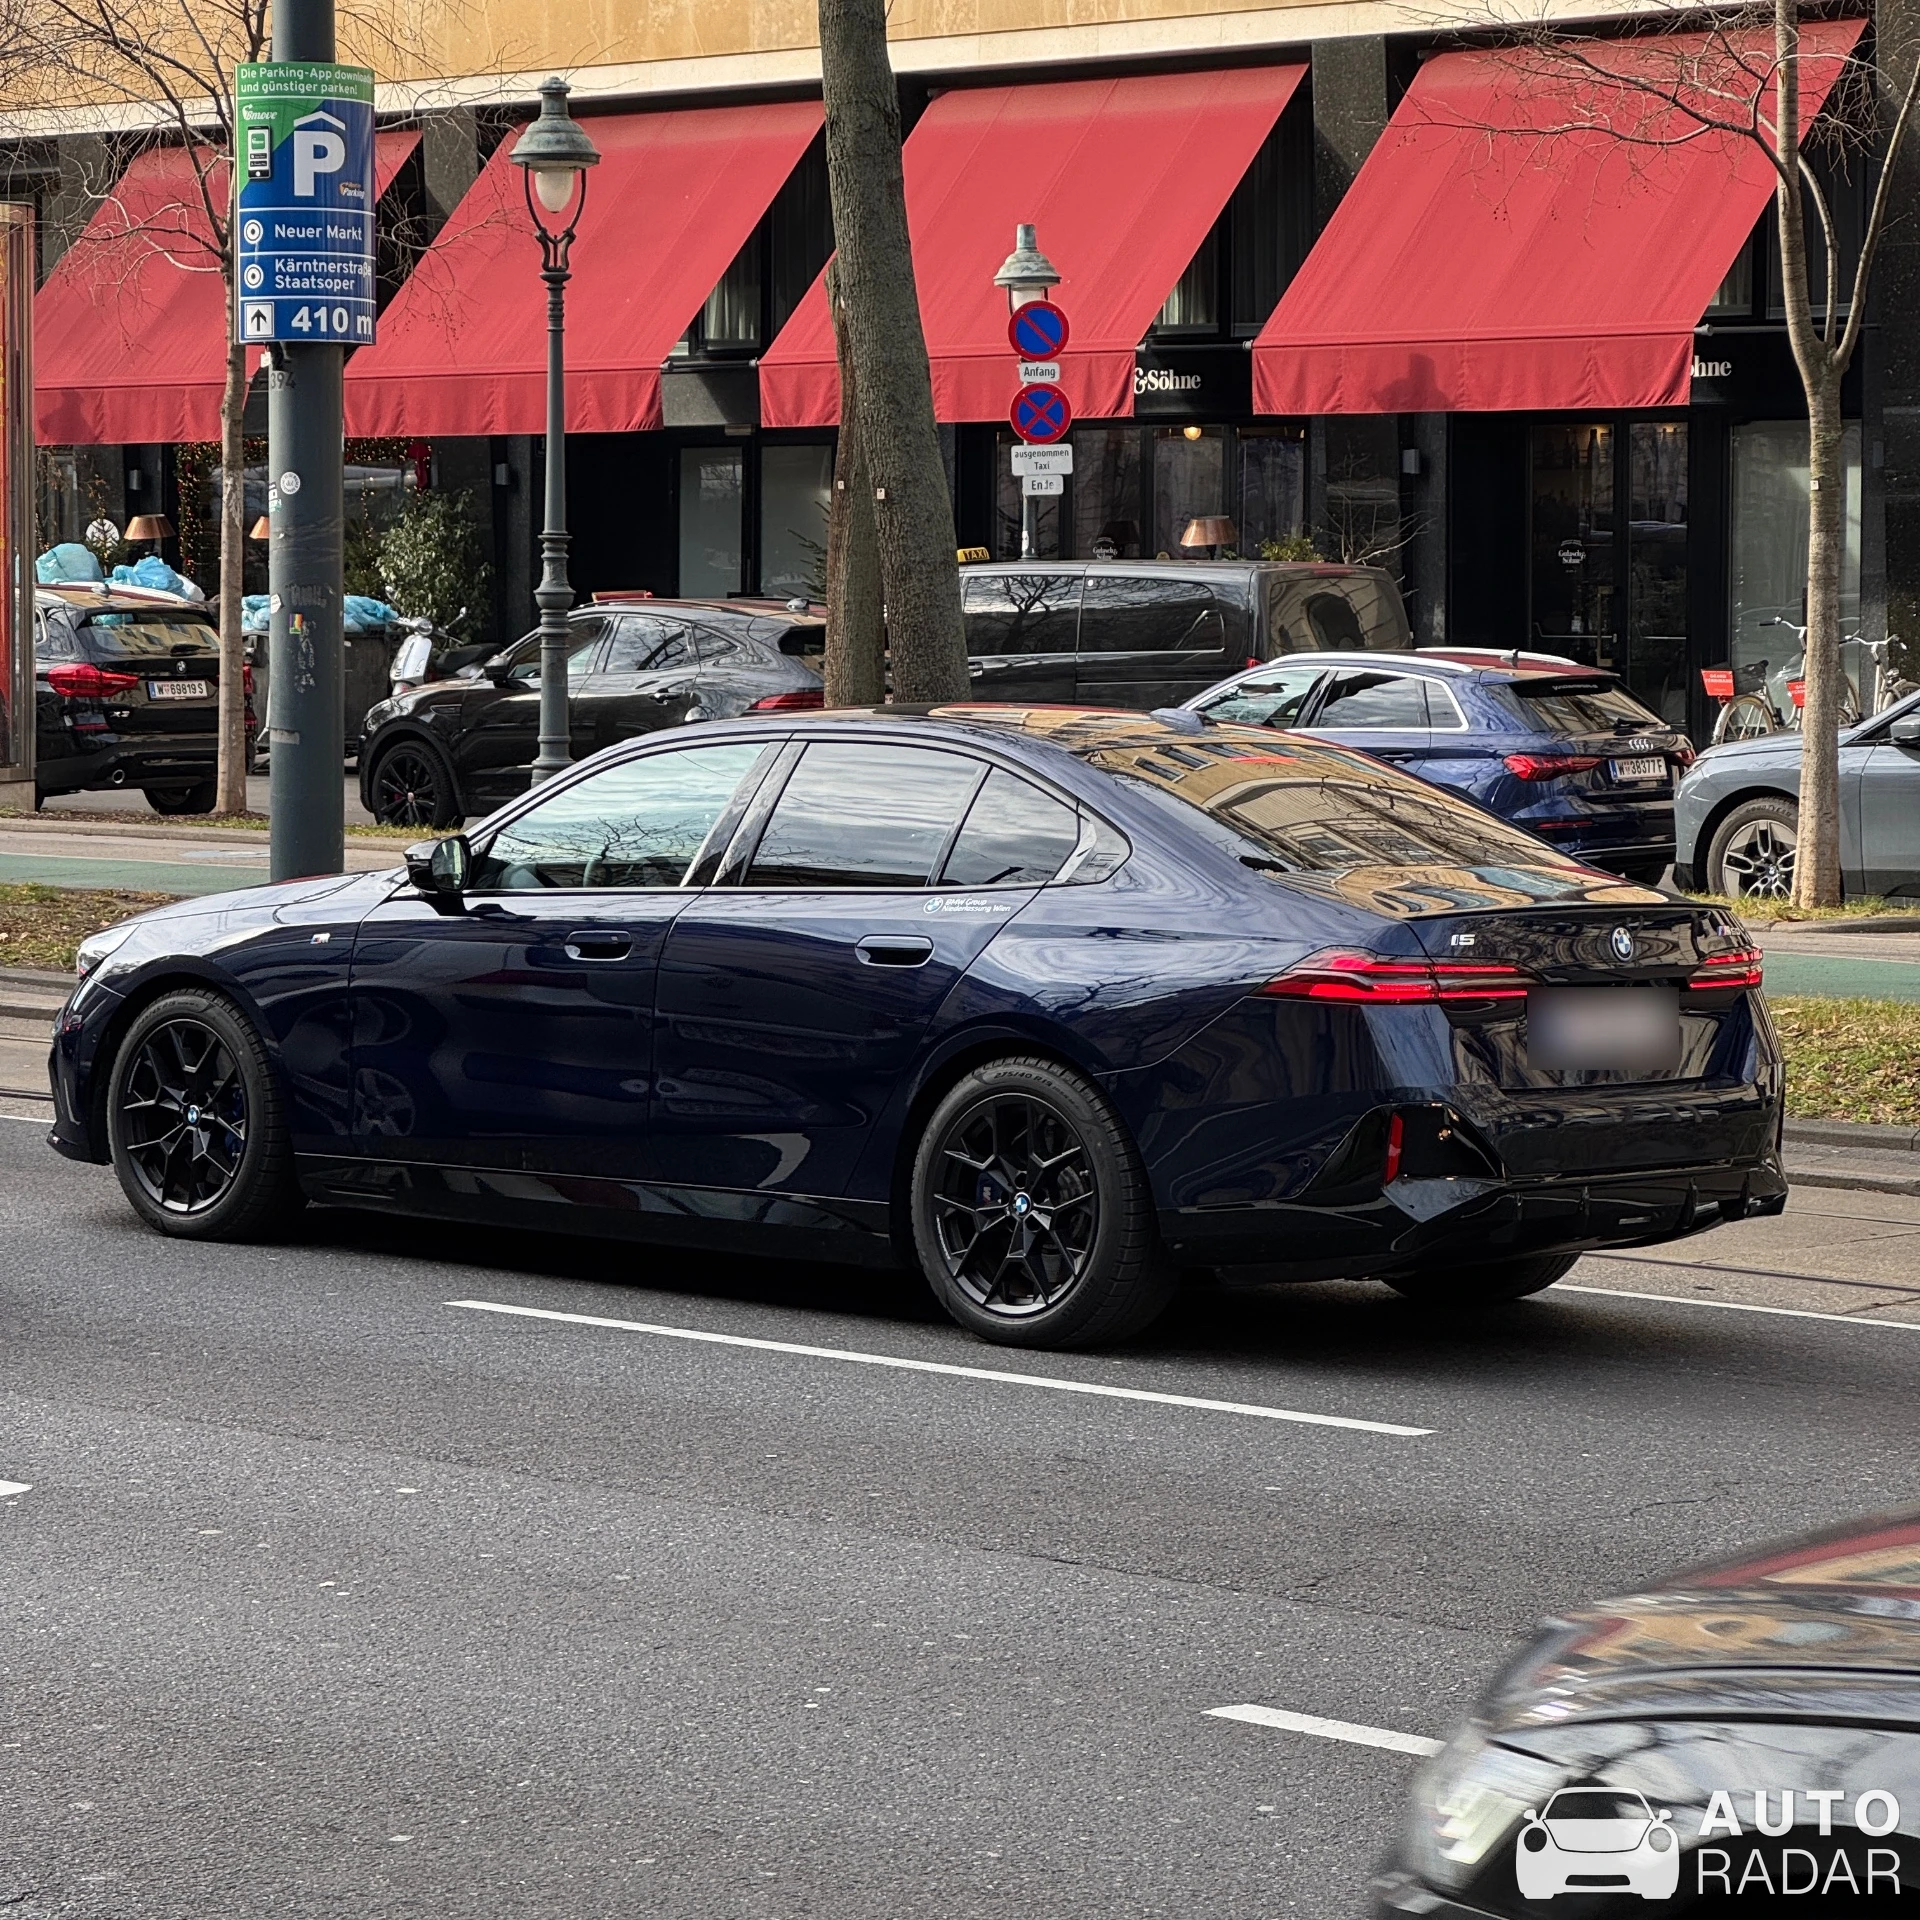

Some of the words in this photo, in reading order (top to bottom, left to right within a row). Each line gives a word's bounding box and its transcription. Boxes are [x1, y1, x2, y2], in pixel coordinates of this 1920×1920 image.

[240, 68, 257, 79] Die
[259, 67, 332, 81] Parking-App
[240, 84, 259, 93] und
[261, 81, 318, 94] günstiger
[320, 83, 358, 95] parken!
[293, 130, 346, 196] P
[274, 224, 322, 239] Neuer
[326, 224, 363, 241] Markt
[274, 258, 372, 278] Kärntnerstraße
[274, 275, 356, 292] Staatsoper
[291, 306, 349, 333] 410
[356, 315, 372, 335] m
[1023, 366, 1057, 379] Anfang
[1014, 449, 1070, 459] ausgenommen
[1034, 461, 1050, 470] Taxi
[963, 549, 988, 560] TAXI
[170, 683, 197, 695] 69819
[197, 683, 204, 695] S
[1630, 760, 1656, 775] 38377
[945, 898, 965, 906] BMW
[965, 898, 988, 906] Group
[992, 904, 1011, 912] Wien
[993, 1071, 1033, 1080] 275/40
